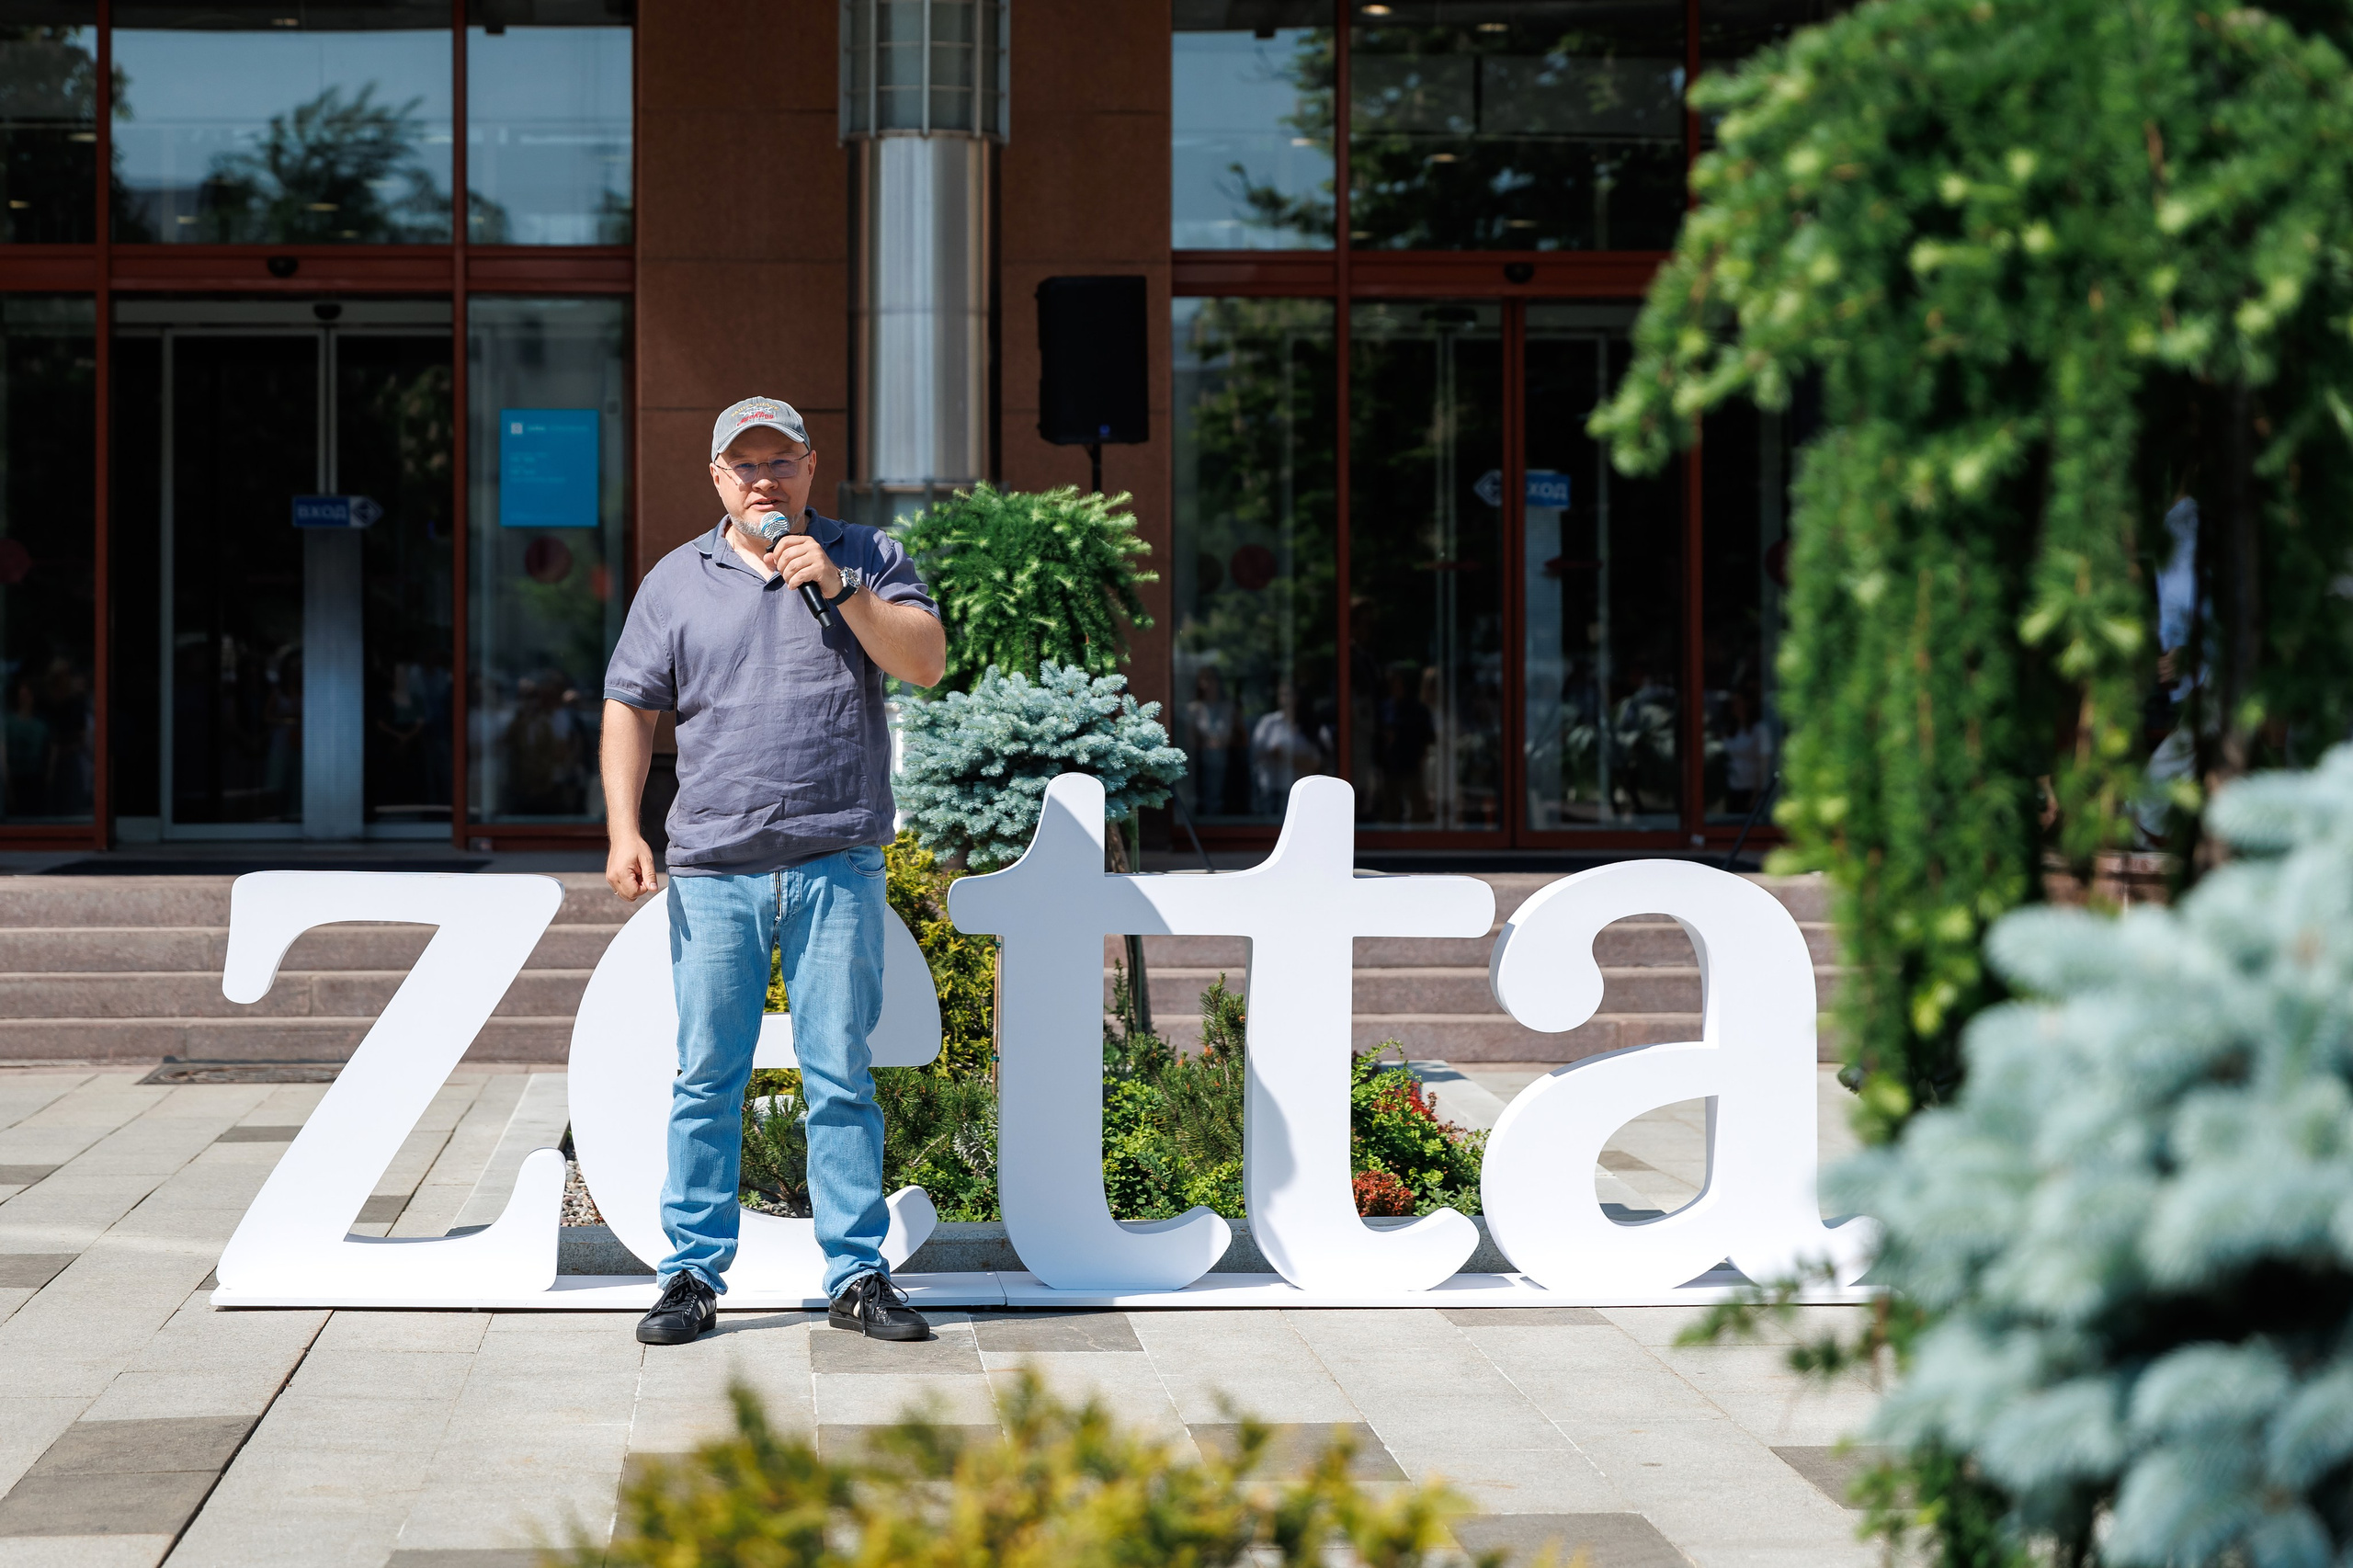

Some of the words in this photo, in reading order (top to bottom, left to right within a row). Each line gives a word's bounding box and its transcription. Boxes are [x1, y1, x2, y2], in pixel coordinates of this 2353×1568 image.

[1527, 482, 1567, 499] ХОД
[297, 505, 347, 519] ВХОД
[216, 773, 1882, 1292] zetta
